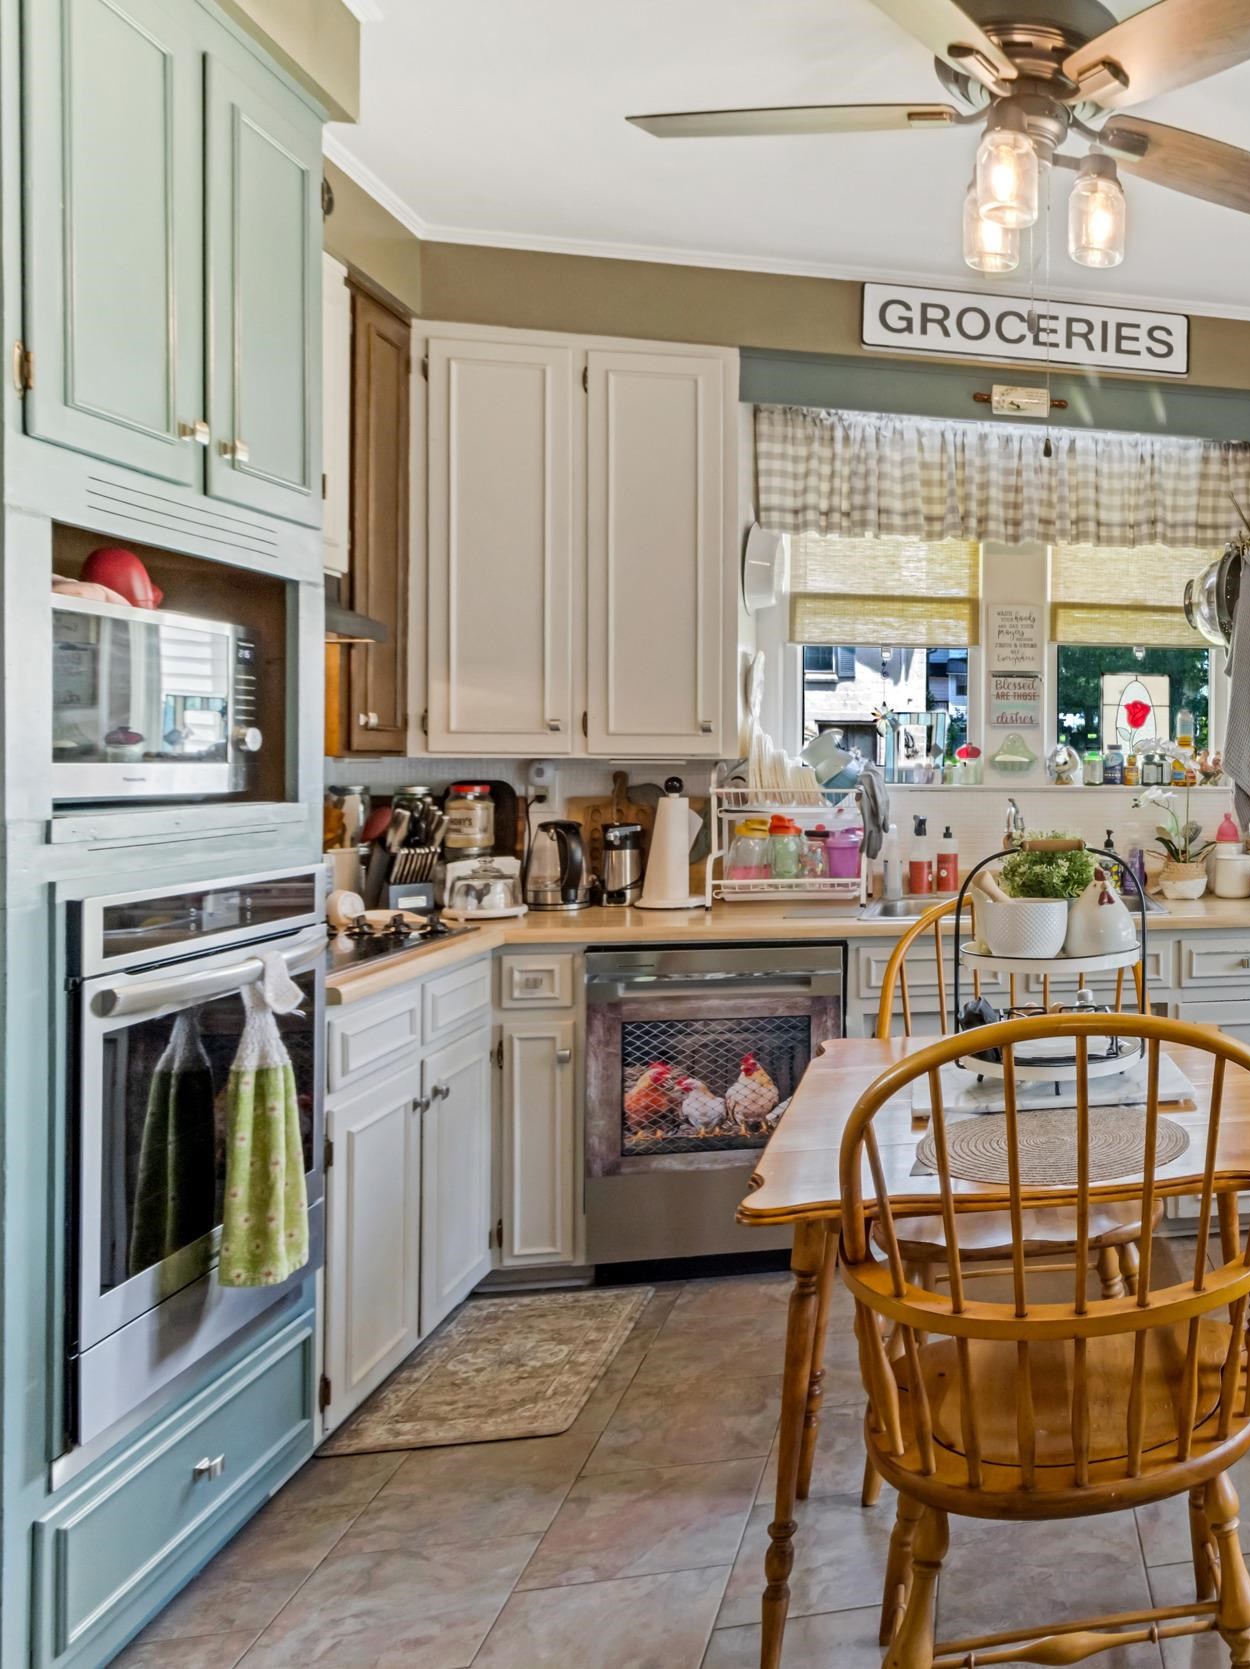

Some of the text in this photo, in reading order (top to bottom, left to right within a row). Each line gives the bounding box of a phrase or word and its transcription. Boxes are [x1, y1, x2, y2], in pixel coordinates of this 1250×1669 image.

[877, 298, 1175, 359] GROCERIES
[995, 679, 1037, 691] Blessed
[995, 691, 1037, 701] ARE THOSE
[996, 712, 1034, 724] dishes
